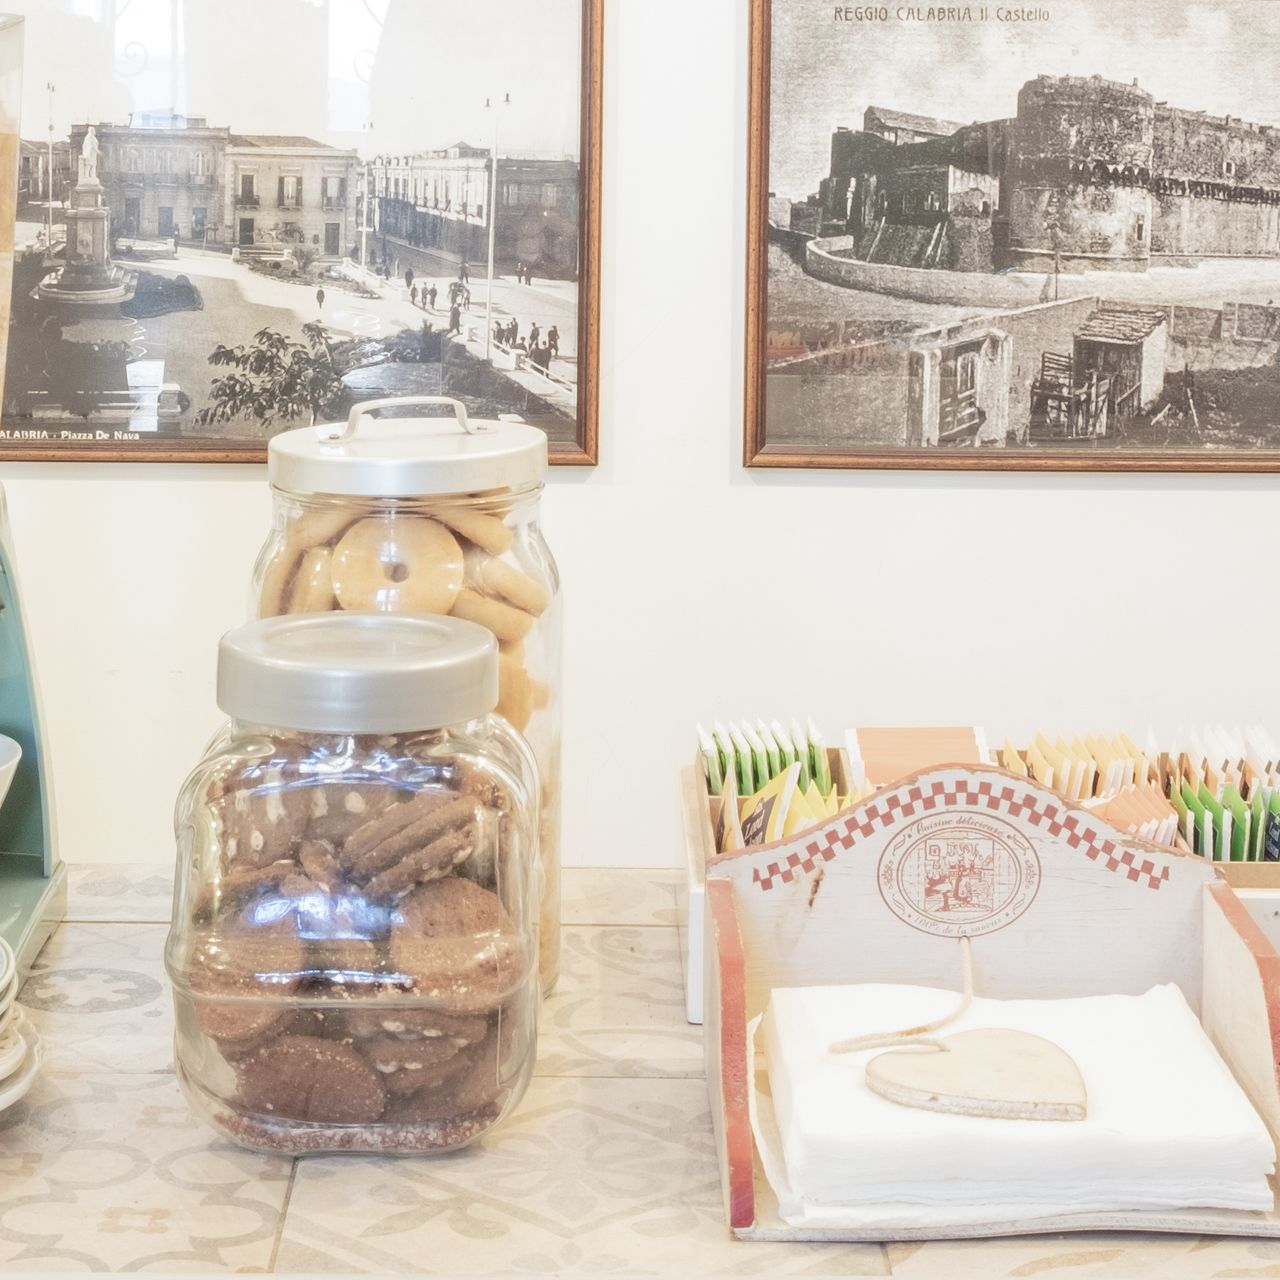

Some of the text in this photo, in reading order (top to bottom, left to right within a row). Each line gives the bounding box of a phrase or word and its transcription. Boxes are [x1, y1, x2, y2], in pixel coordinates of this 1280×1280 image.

[834, 6, 888, 21] REGGIO
[979, 7, 988, 21] Il
[996, 7, 1050, 21] Castello
[61, 430, 93, 440] Piazza
[95, 430, 109, 440] De
[114, 431, 140, 440] Nava
